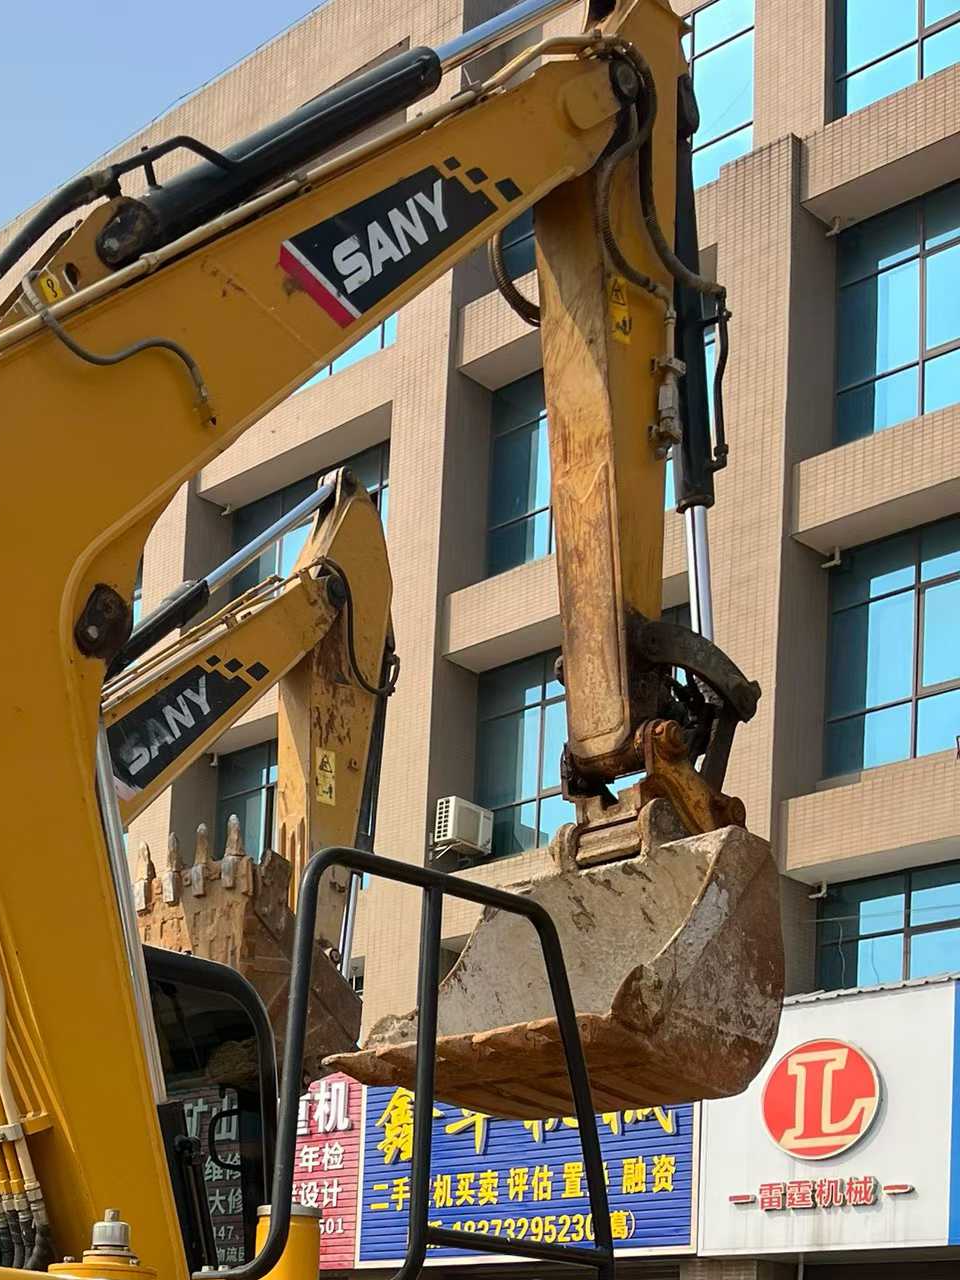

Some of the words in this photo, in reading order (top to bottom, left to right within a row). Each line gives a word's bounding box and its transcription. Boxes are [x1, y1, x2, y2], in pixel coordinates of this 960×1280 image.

[332, 178, 448, 294] SANY
[119, 674, 211, 776] SANY
[300, 1141, 345, 1172] 年检
[292, 1179, 343, 1208] 设计
[369, 1169, 499, 1211] 二手机买卖
[507, 1164, 554, 1201] 评估
[622, 1154, 676, 1193] 融资
[758, 1175, 875, 1211] 雷霆机械
